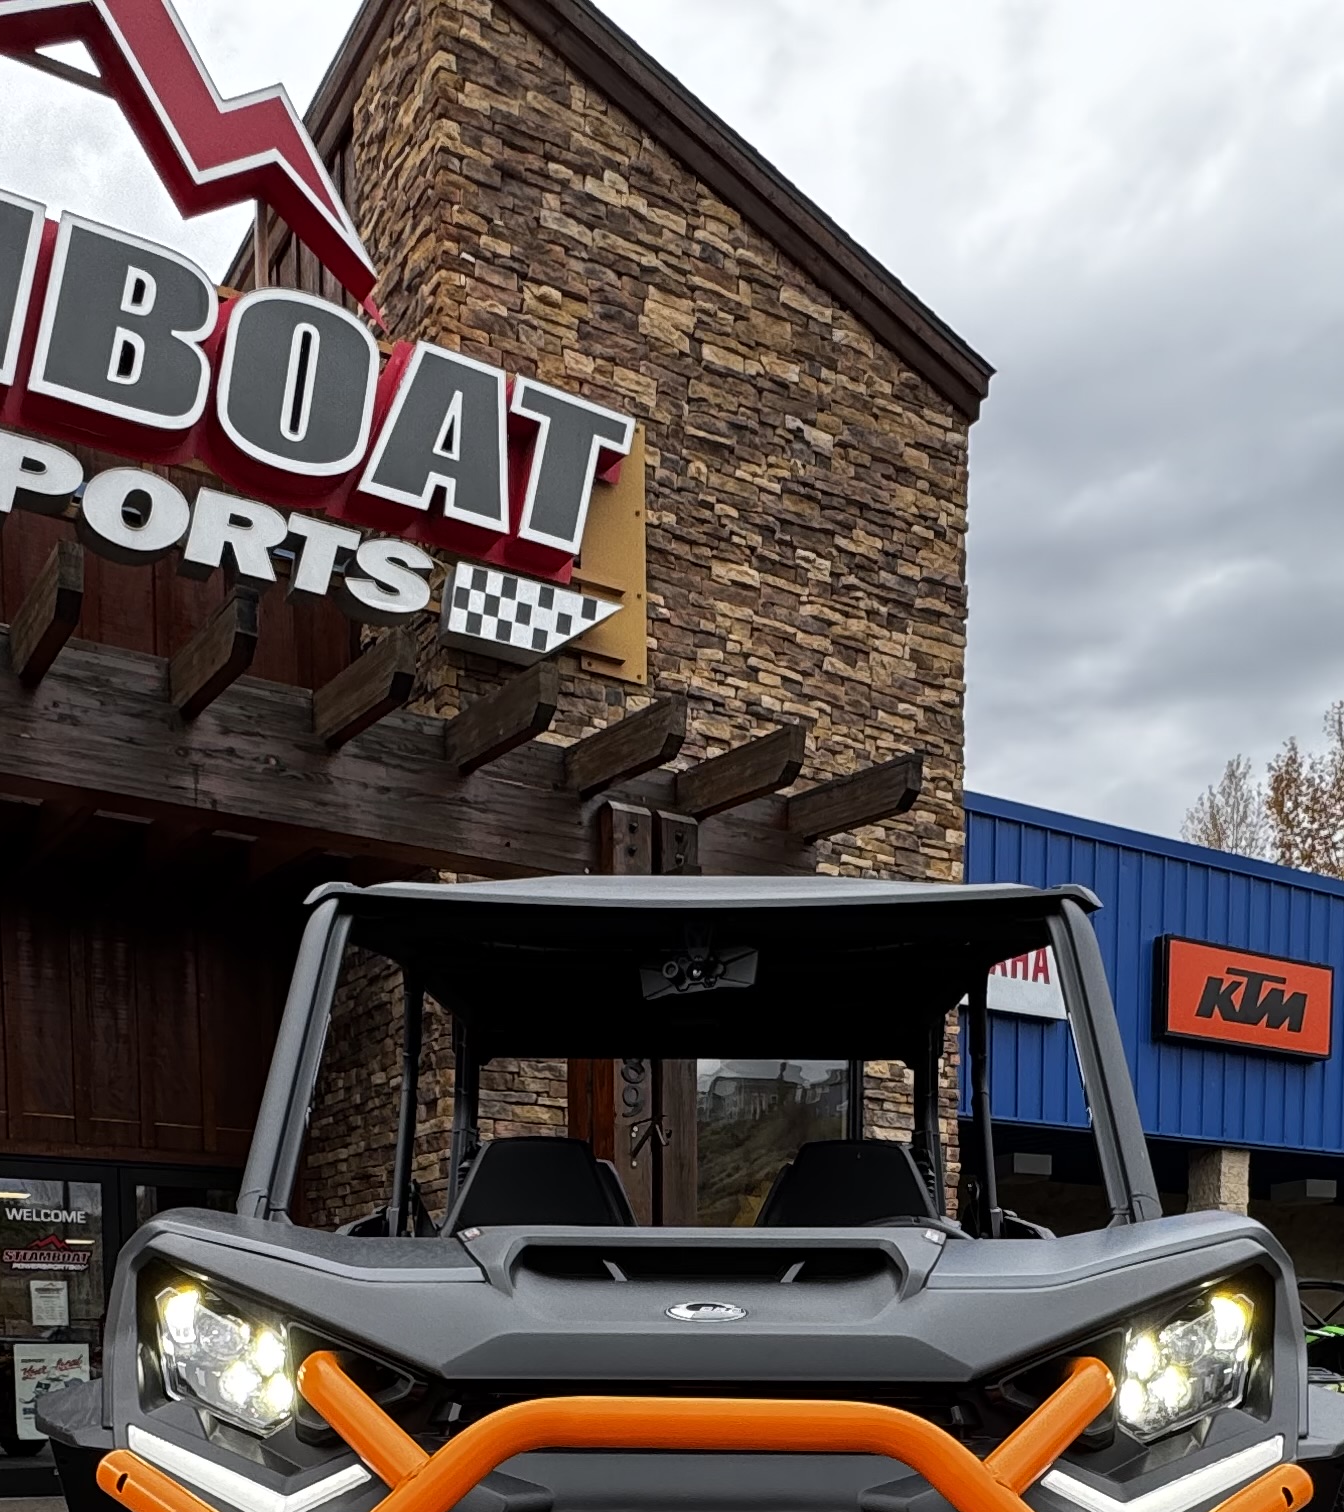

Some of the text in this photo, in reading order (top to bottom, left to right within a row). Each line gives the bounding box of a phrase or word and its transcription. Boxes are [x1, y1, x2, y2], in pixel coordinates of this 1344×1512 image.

[1195, 967, 1308, 1033] KTM
[5, 1207, 87, 1224] WELCOME
[2, 1249, 91, 1264] STEAMBOAT
